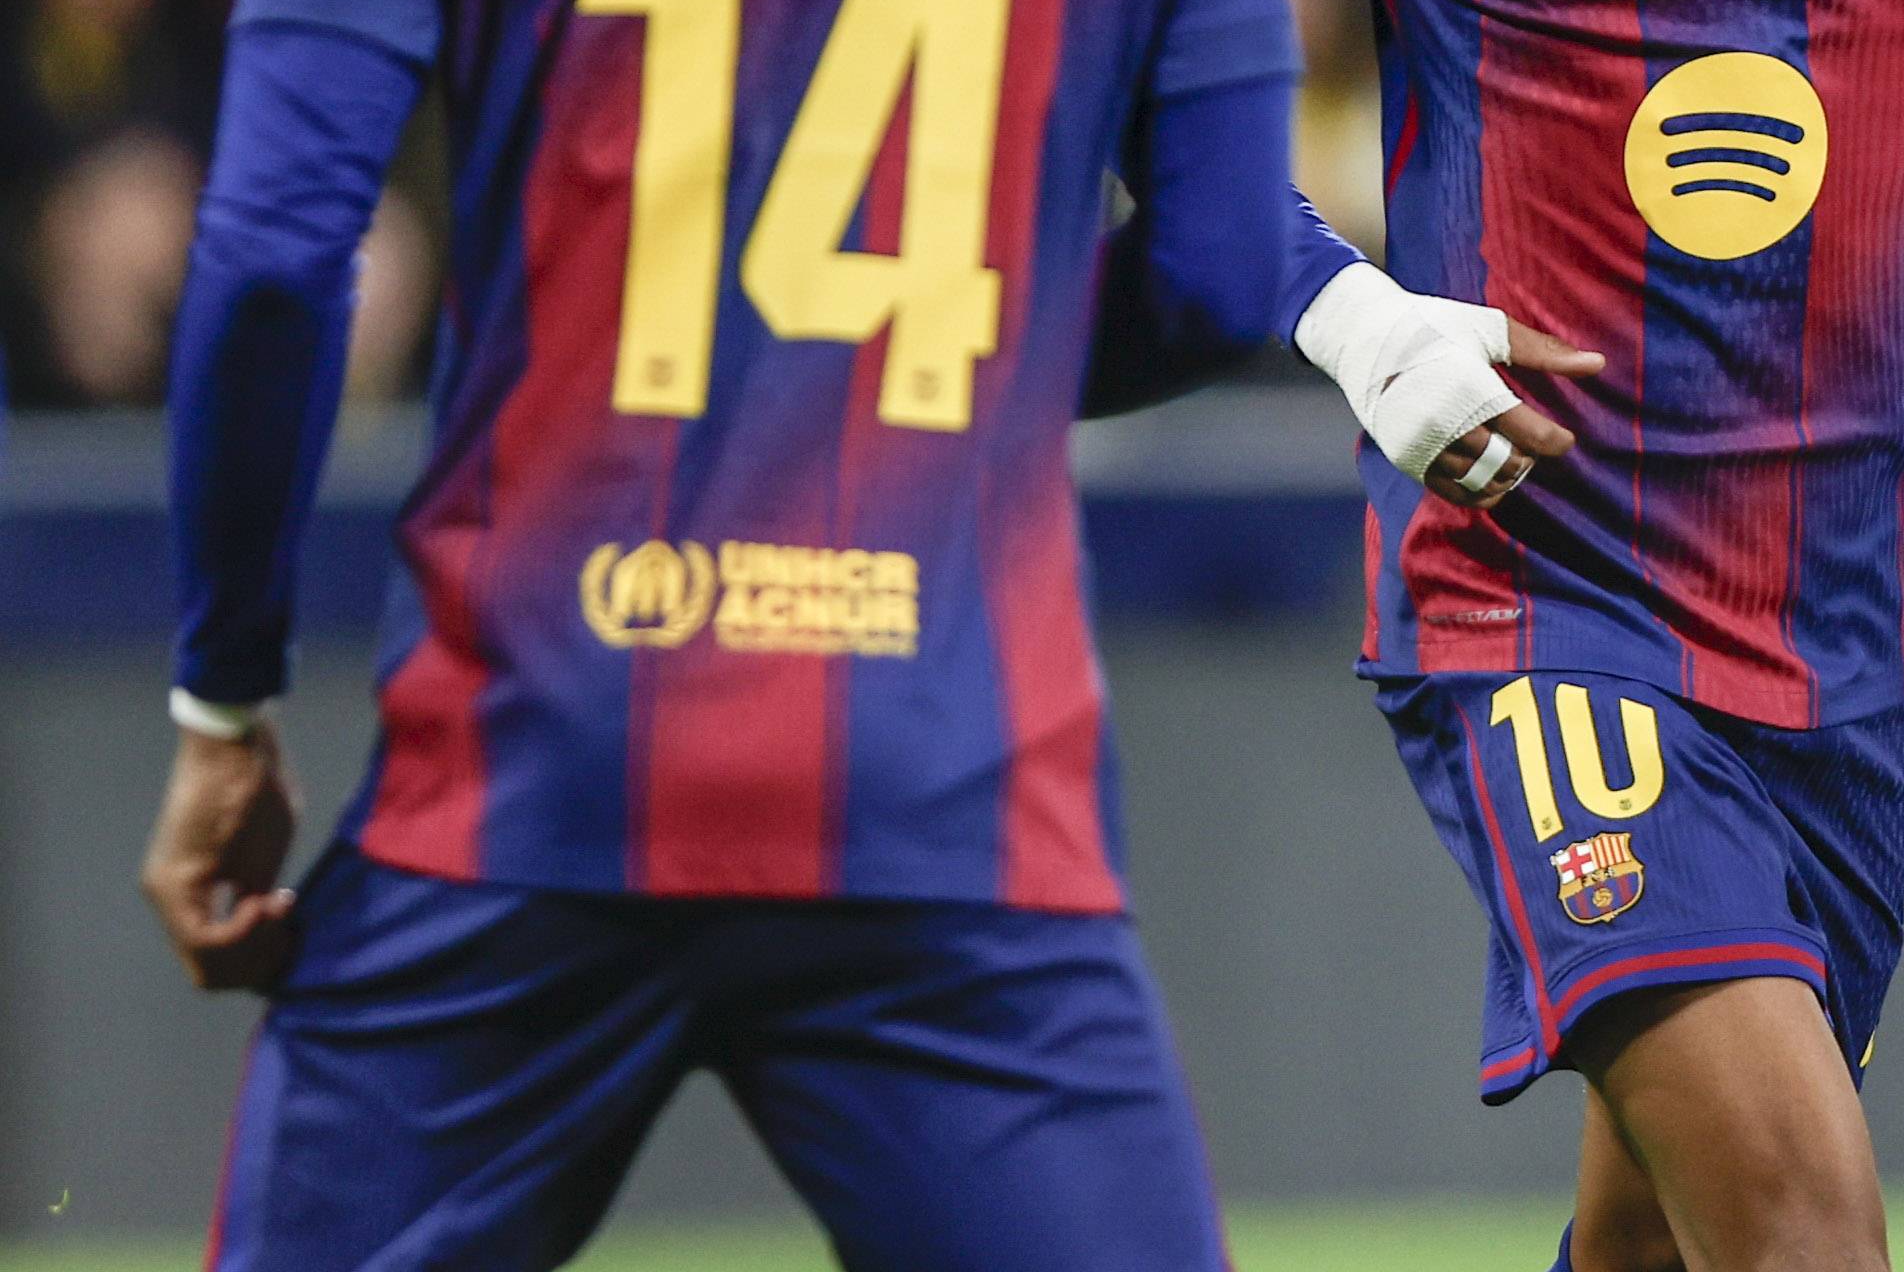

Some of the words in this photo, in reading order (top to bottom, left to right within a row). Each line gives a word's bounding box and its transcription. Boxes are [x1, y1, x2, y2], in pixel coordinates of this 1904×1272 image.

[719, 540, 919, 589] UNHCR
[714, 587, 919, 629] ACNUR
[1490, 675, 1665, 843] 10
